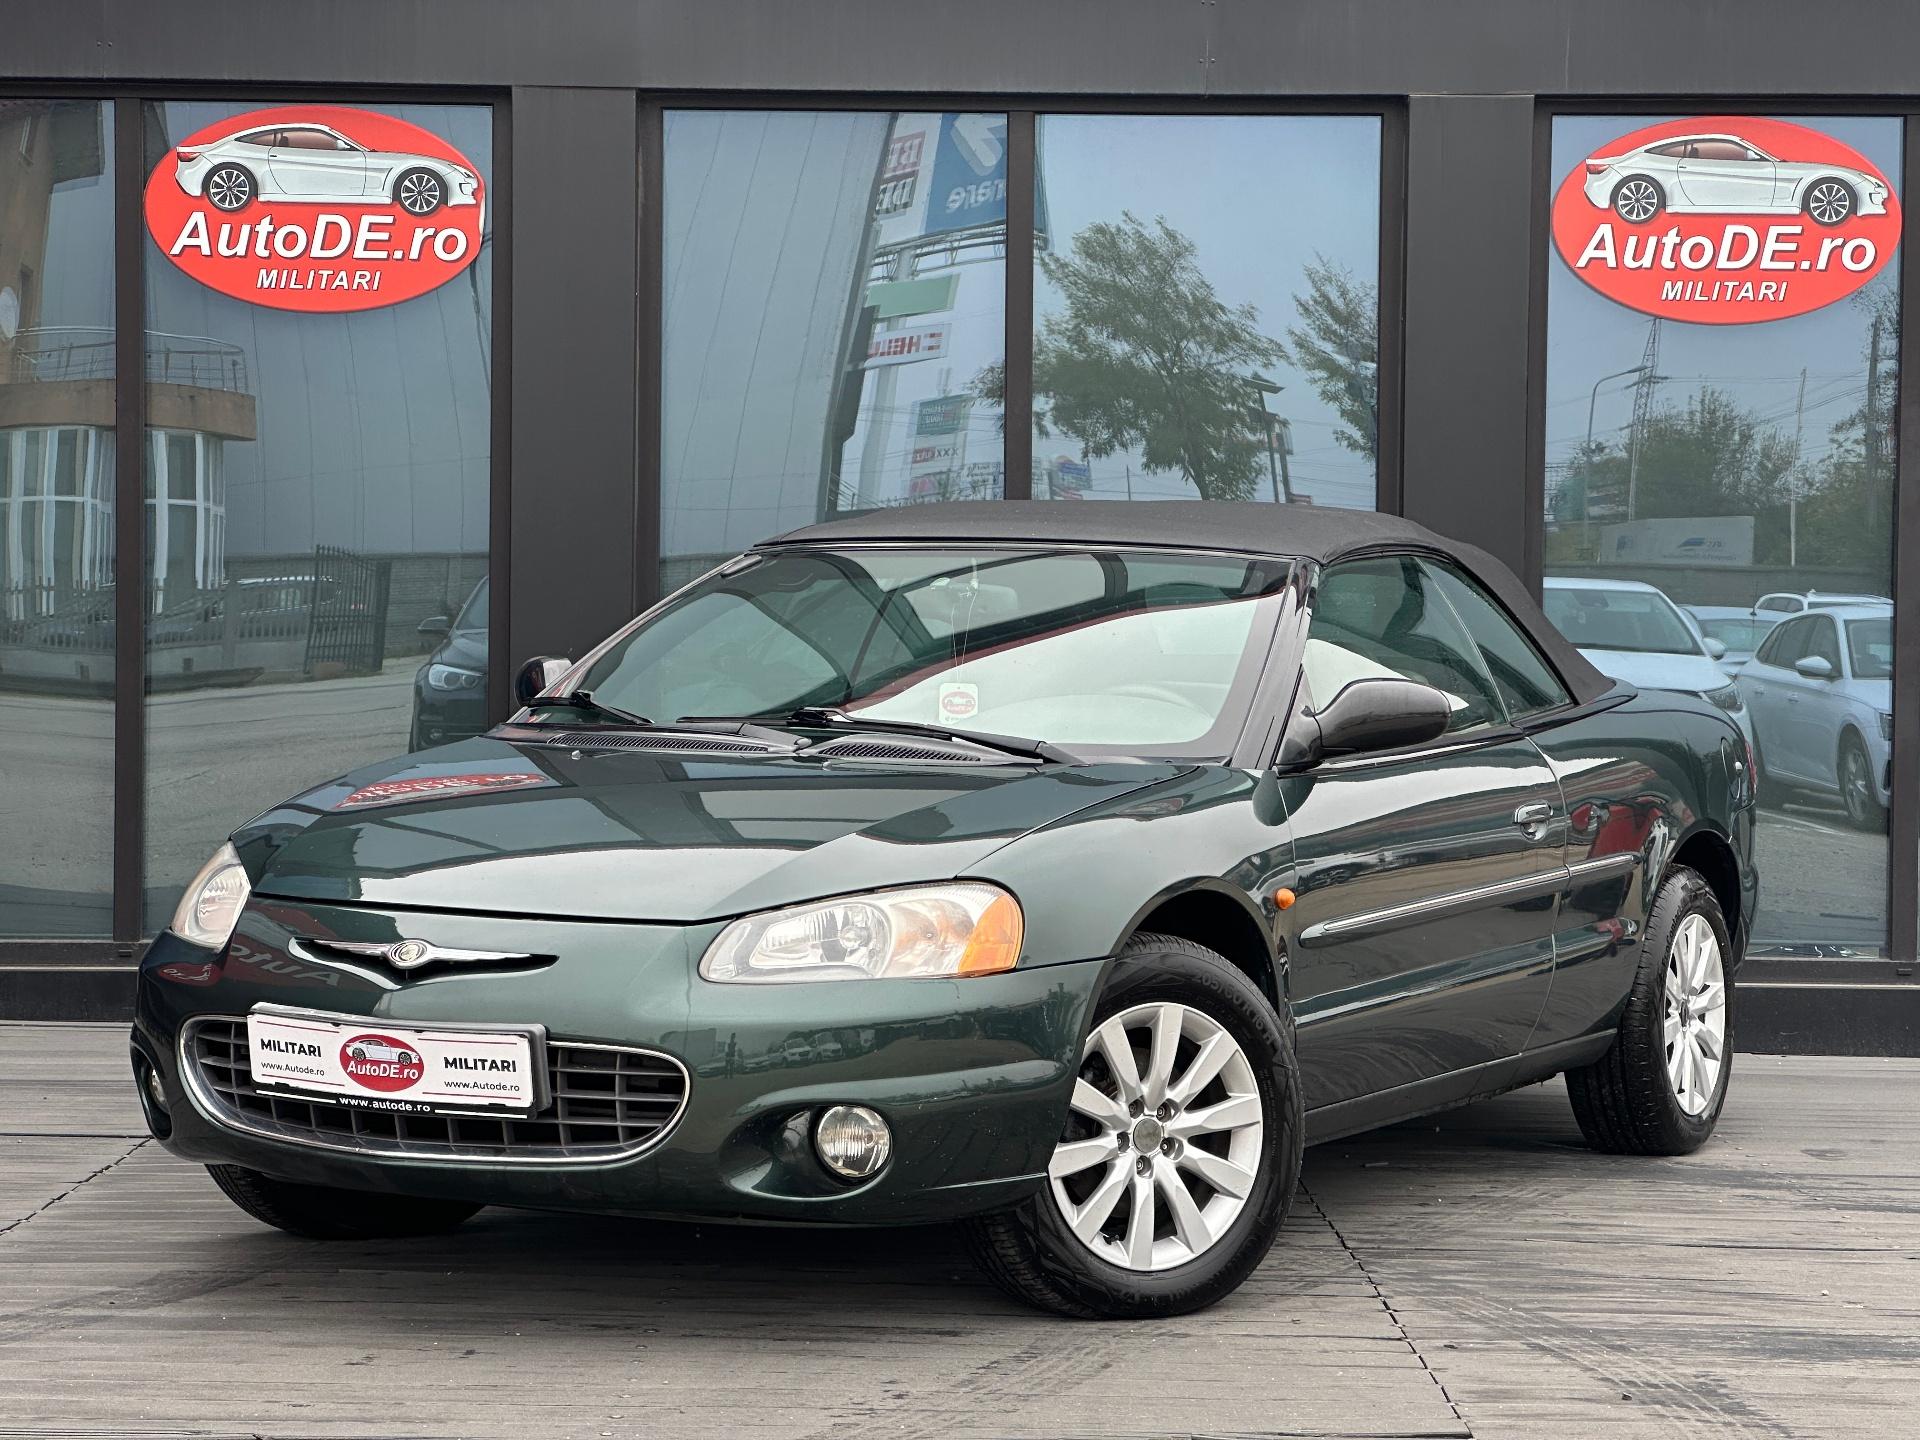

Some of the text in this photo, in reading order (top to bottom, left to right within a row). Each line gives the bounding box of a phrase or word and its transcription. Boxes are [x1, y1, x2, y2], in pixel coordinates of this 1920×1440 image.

[169, 210, 469, 262] AutoDE.ro
[1575, 222, 1876, 272] AutoDE.ro
[256, 268, 381, 291] MILITARI
[1660, 280, 1789, 302] MILITARI
[260, 1038, 322, 1058] MILITARI
[260, 1061, 326, 1077] www.Autode.ro
[346, 1060, 420, 1081] AutoDE.ro
[443, 1056, 517, 1073] MILITARI
[443, 1078, 521, 1093] www.Autode.ro
[338, 1096, 431, 1112] www.autode.ro
